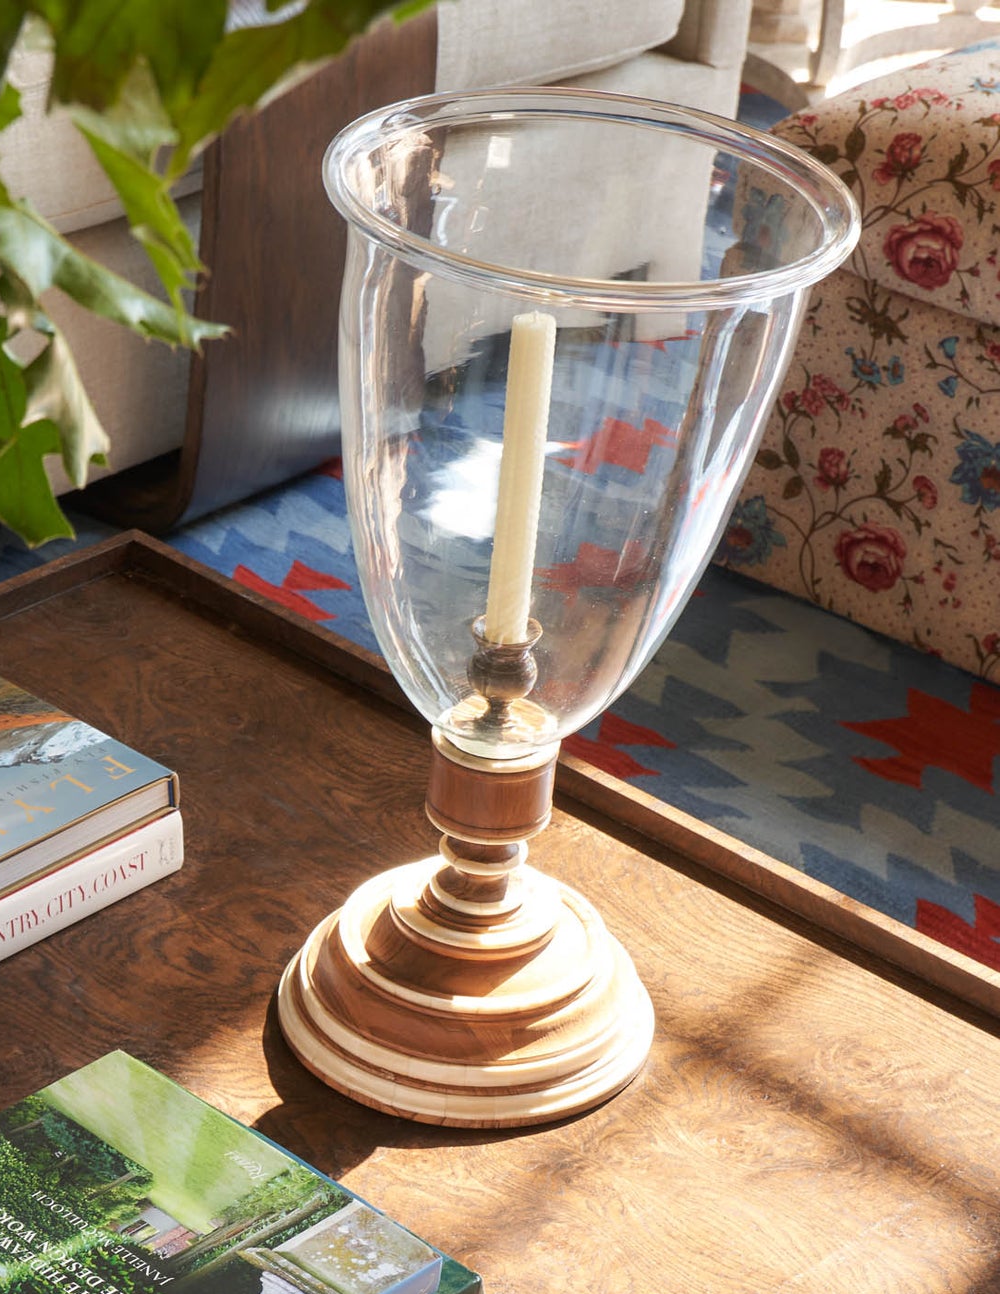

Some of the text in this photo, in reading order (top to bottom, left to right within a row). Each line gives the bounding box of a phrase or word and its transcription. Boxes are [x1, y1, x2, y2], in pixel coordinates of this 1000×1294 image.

[92, 850, 150, 894] COAST
[36, 1240, 106, 1288] DESIGN
[111, 1244, 175, 1286] JANELLE
